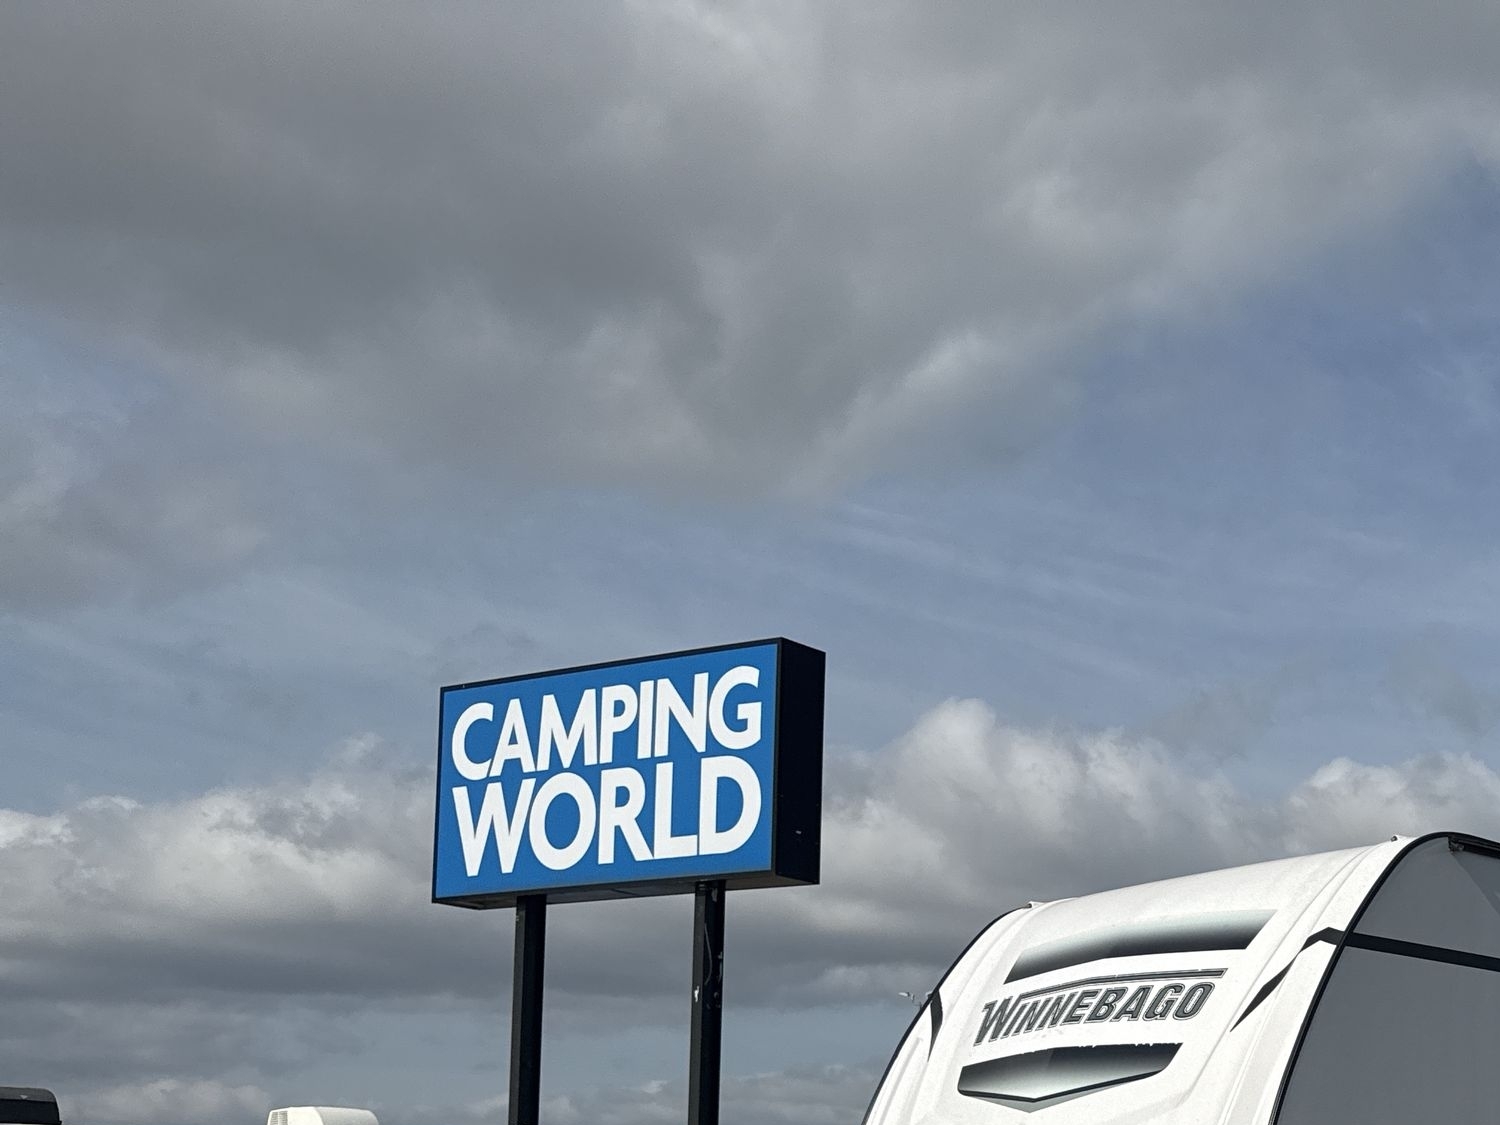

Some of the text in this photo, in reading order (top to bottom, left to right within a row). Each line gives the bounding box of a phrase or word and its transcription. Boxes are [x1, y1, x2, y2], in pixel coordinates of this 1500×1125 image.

[452, 665, 762, 780] CAMPING
[452, 755, 762, 877] WORLD
[973, 982, 1215, 1046] WINNEBAGO
